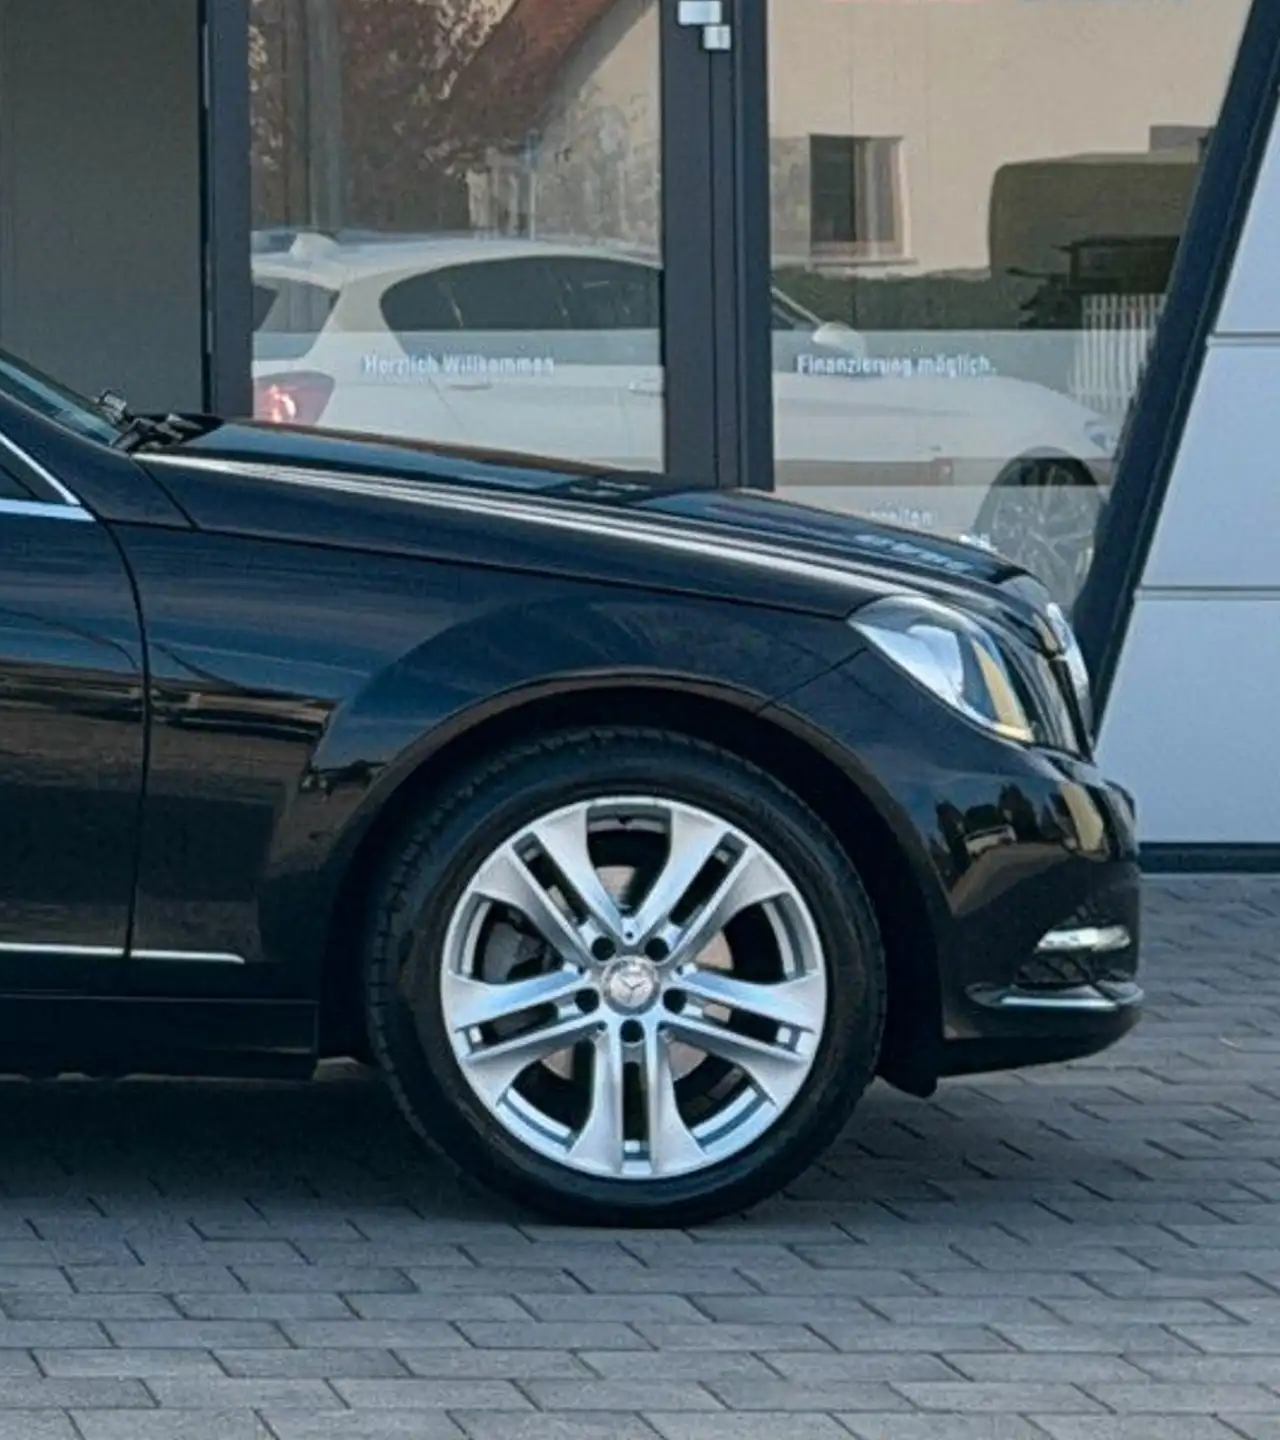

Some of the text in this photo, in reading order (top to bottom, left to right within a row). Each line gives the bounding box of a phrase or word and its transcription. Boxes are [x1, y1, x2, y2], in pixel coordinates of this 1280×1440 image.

[362, 353, 554, 375] Herzlich Willkommen
[797, 354, 912, 377] Finanzierung
